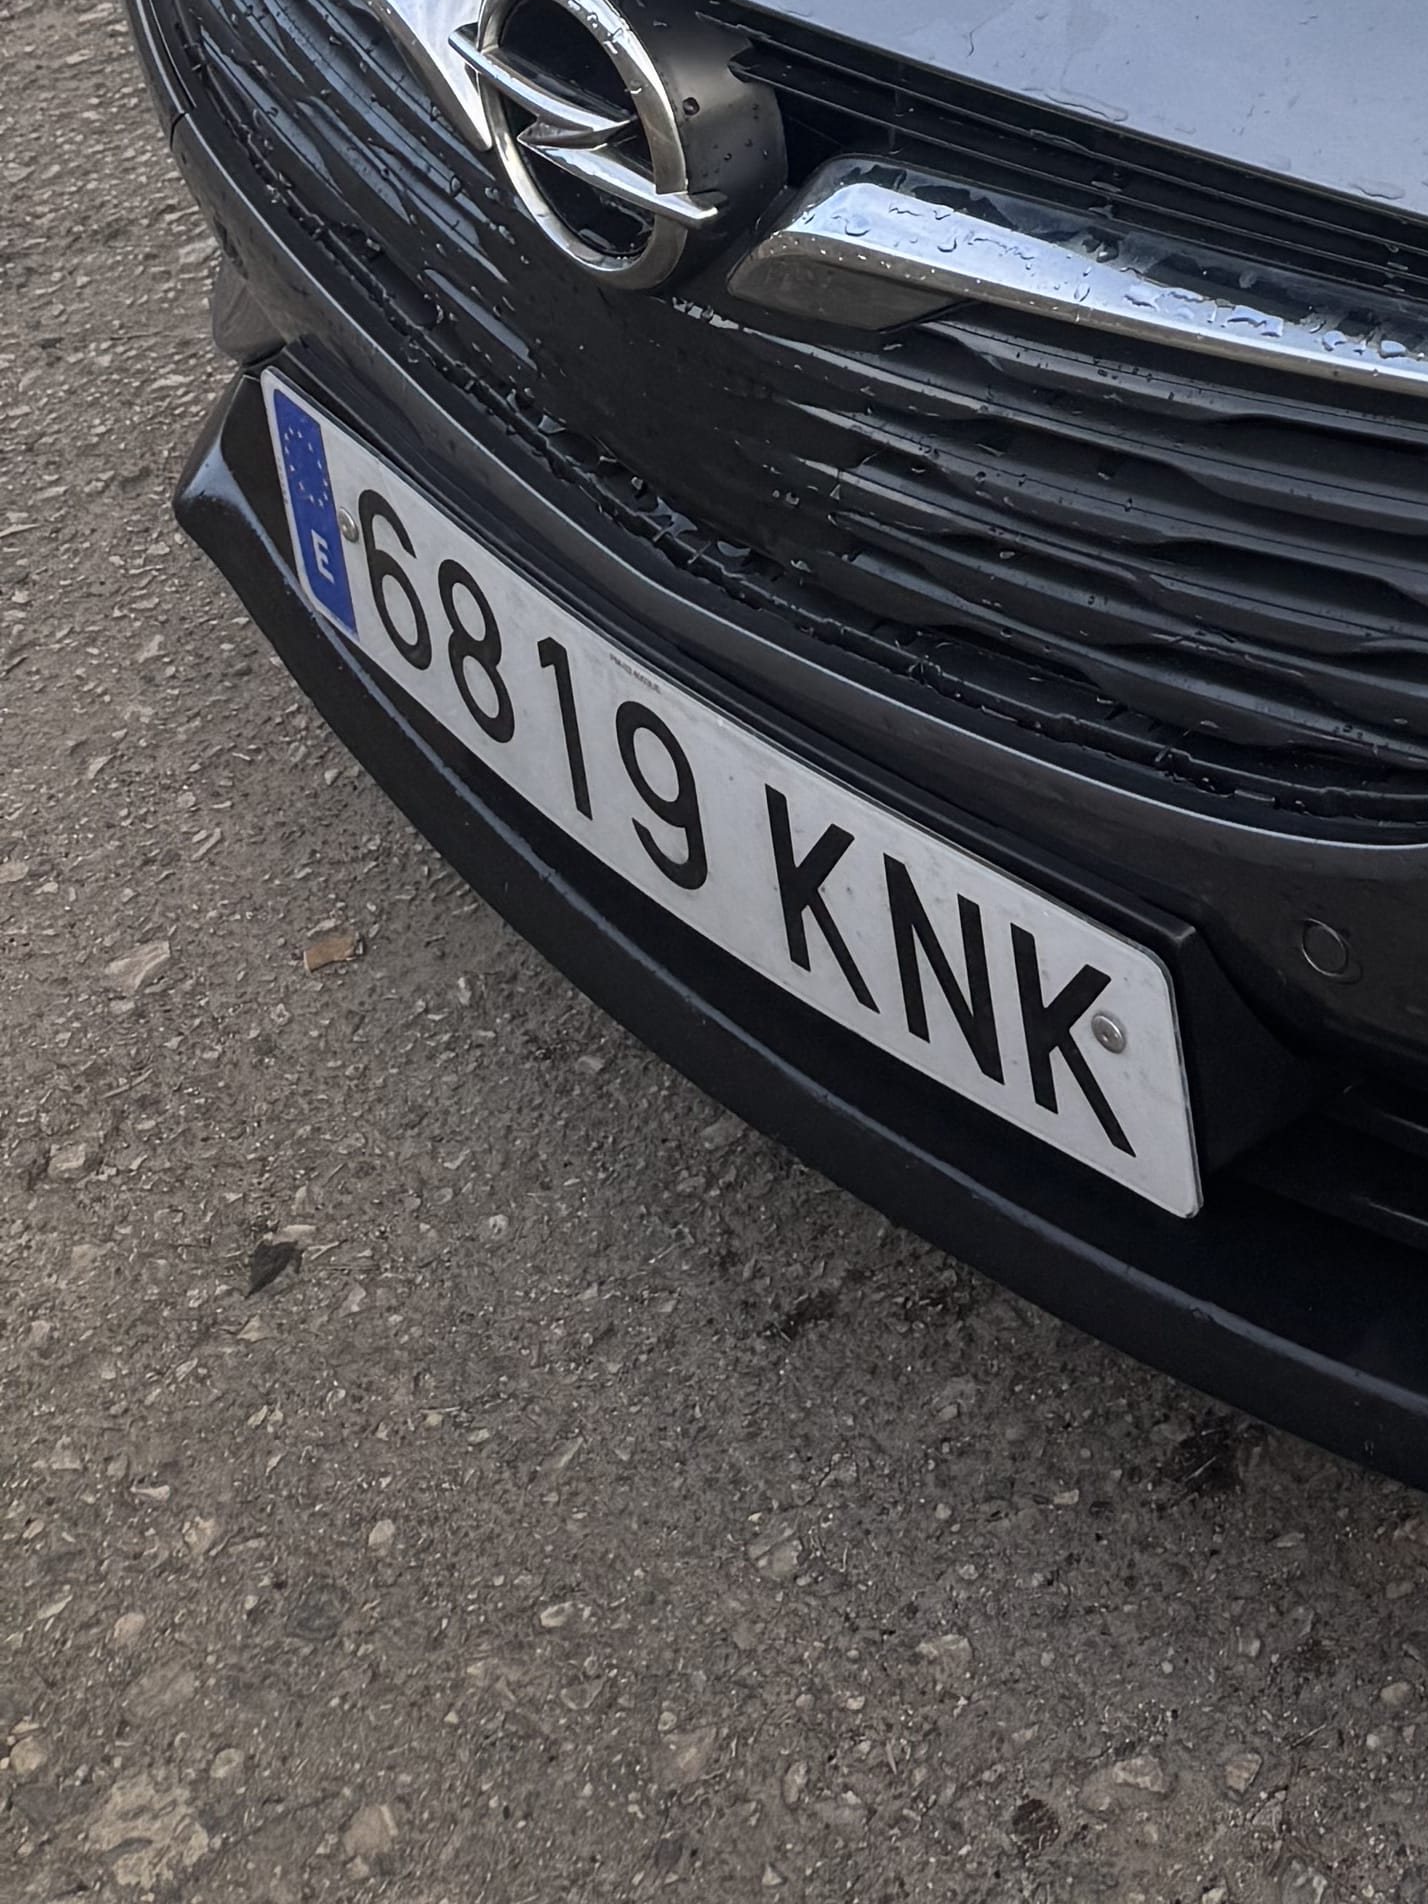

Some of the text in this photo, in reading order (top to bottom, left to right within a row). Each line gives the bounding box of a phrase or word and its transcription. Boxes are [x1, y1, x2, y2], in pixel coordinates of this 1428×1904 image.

[310, 528, 335, 585] E
[357, 489, 1137, 1158] 6819 KNK
